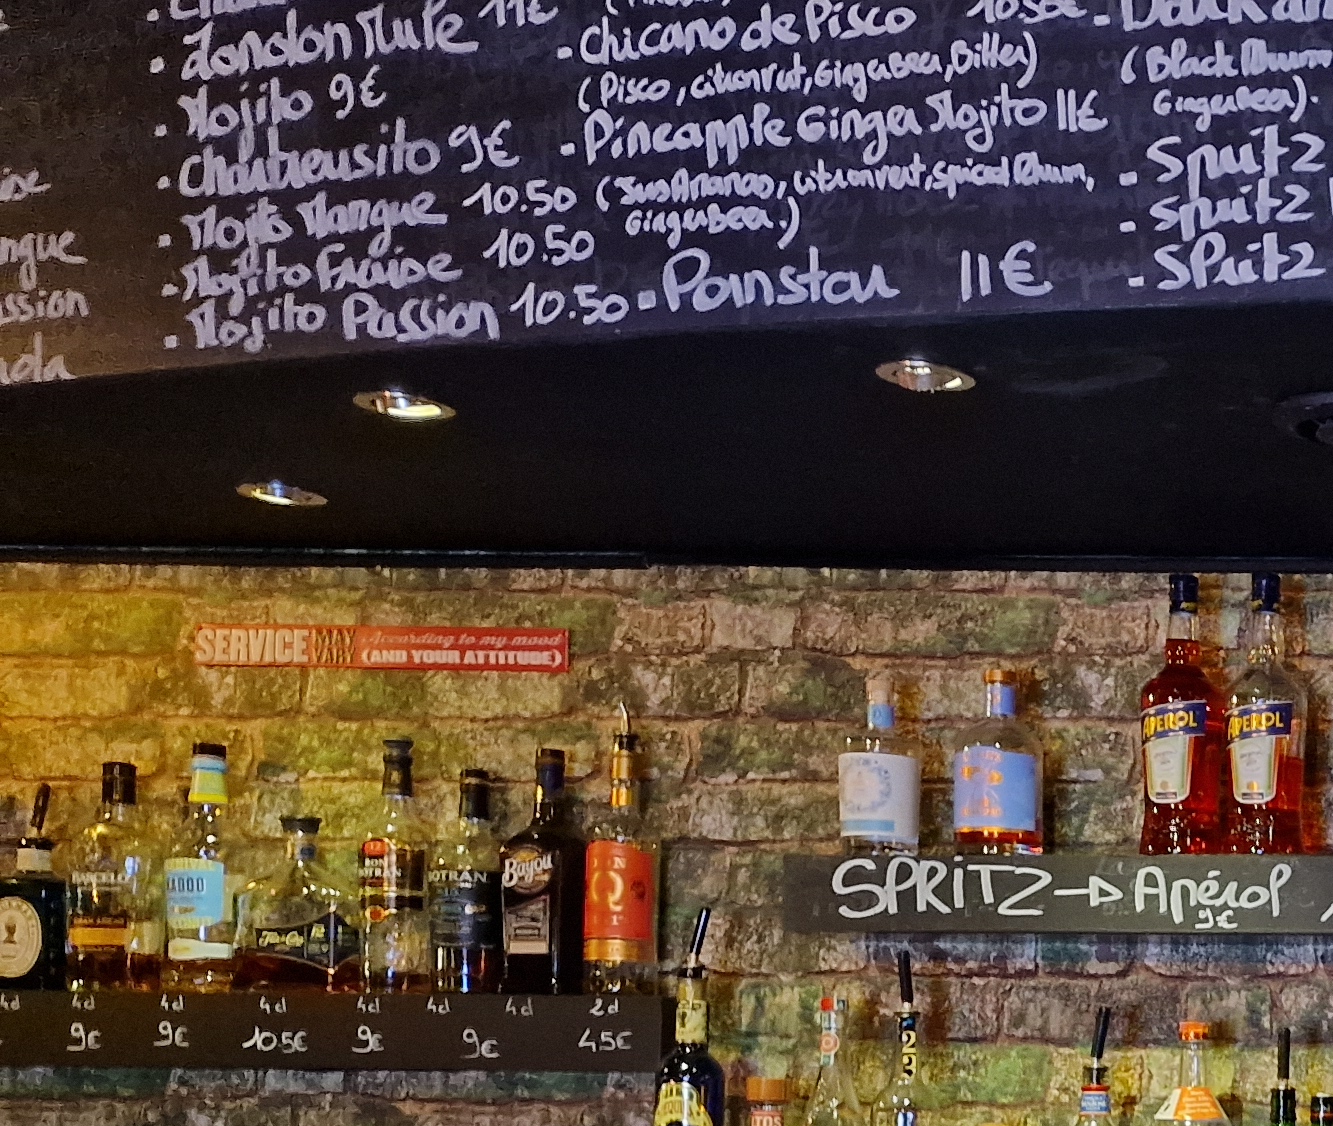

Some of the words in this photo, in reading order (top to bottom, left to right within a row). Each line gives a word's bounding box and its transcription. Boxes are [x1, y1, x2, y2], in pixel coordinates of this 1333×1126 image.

[181, 9, 352, 80] London
[361, 0, 480, 58] Mule
[580, 16, 736, 65] Chicano
[740, 10, 799, 52] de
[803, 1, 917, 42] Pisco
[180, 77, 314, 163] Mojito
[329, 65, 386, 118] 9€
[584, 102, 792, 168] Pineapple
[797, 105, 923, 165] Ginger
[926, 83, 1047, 153] Mojito
[1056, 88, 1109, 132] 11€
[448, 121, 519, 169] 9€
[298, 190, 447, 257] Mangue
[464, 182, 577, 216] 10.50
[317, 243, 463, 292] Fraise
[484, 225, 594, 267] 10.50
[960, 240, 1053, 302] 11€
[343, 293, 499, 342] Passion
[510, 282, 629, 327] 10.50
[200, 628, 309, 664] SERVICE
[361, 648, 407, 666] (AND
[411, 649, 461, 666] YOUR
[464, 649, 562, 667] ATTITUDE)
[458, 632, 476, 647] to
[479, 633, 505, 650] my
[508, 632, 562, 647] mood
[1143, 711, 1198, 741] APEROL
[1228, 711, 1284, 741] APEROL
[502, 854, 553, 887] Bayou
